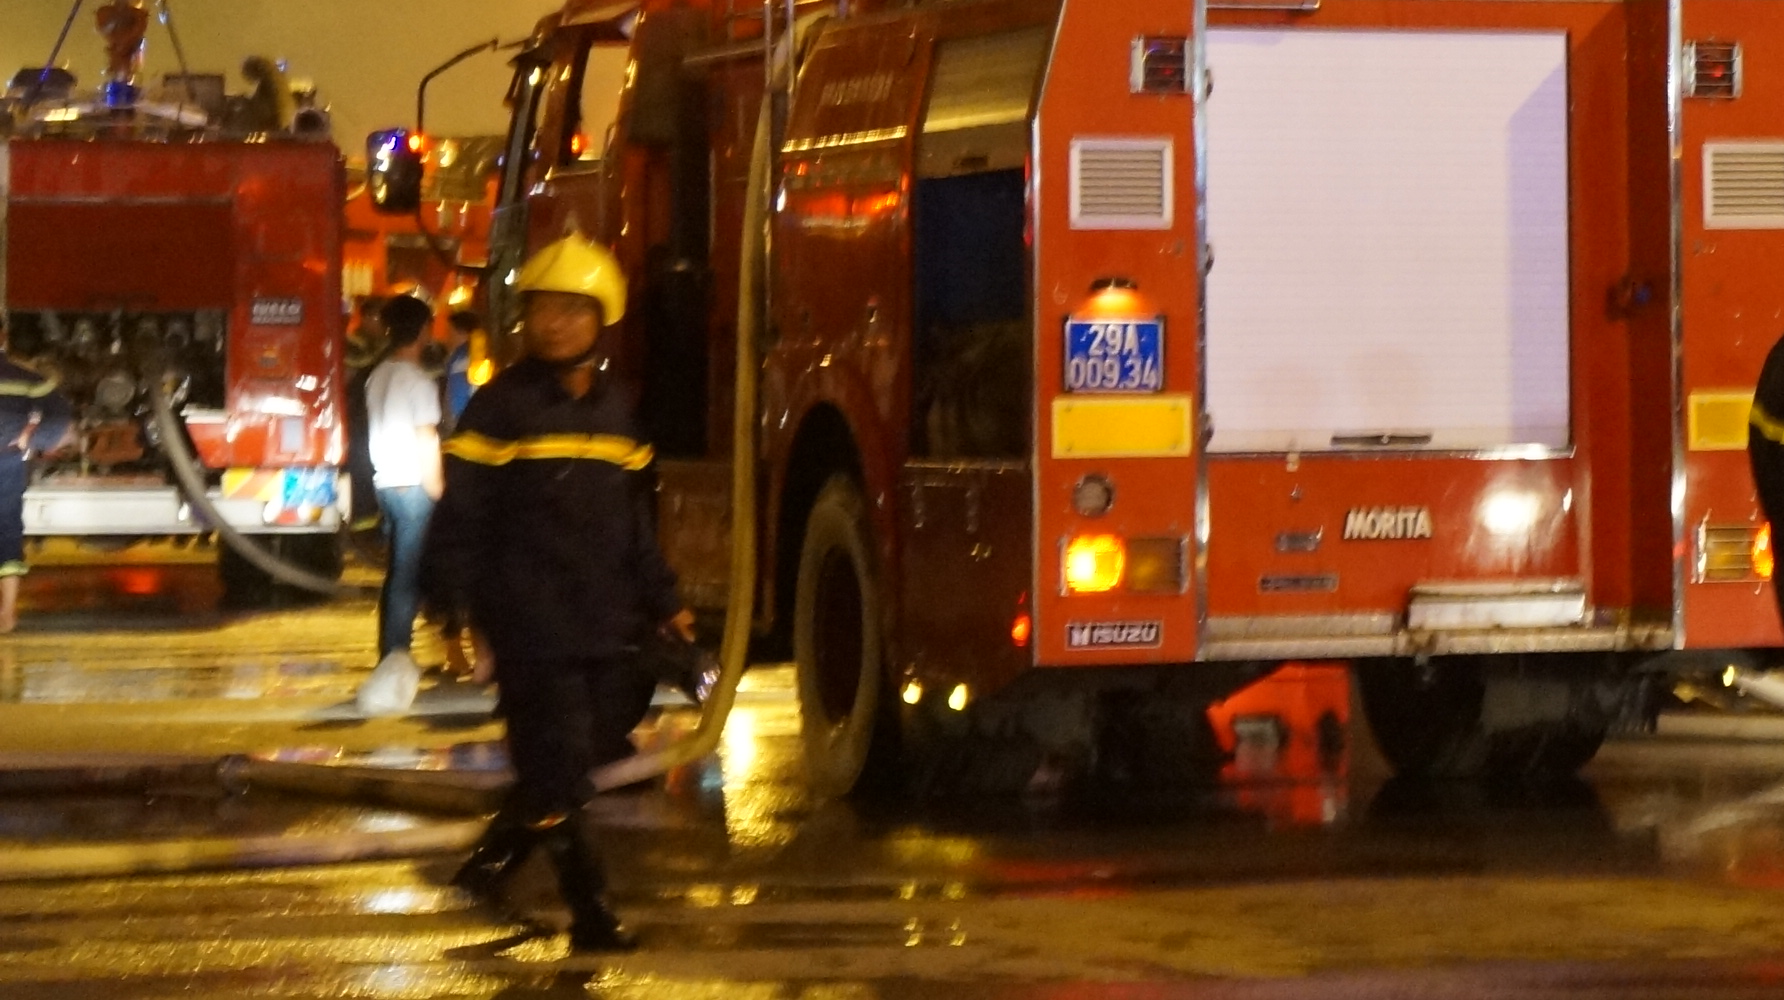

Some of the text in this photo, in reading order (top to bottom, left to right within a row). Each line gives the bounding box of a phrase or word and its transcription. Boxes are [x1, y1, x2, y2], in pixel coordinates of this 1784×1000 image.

[1088, 323, 1140, 356] 29A
[1069, 353, 1158, 390] 009.34
[1343, 505, 1432, 540] MORITA
